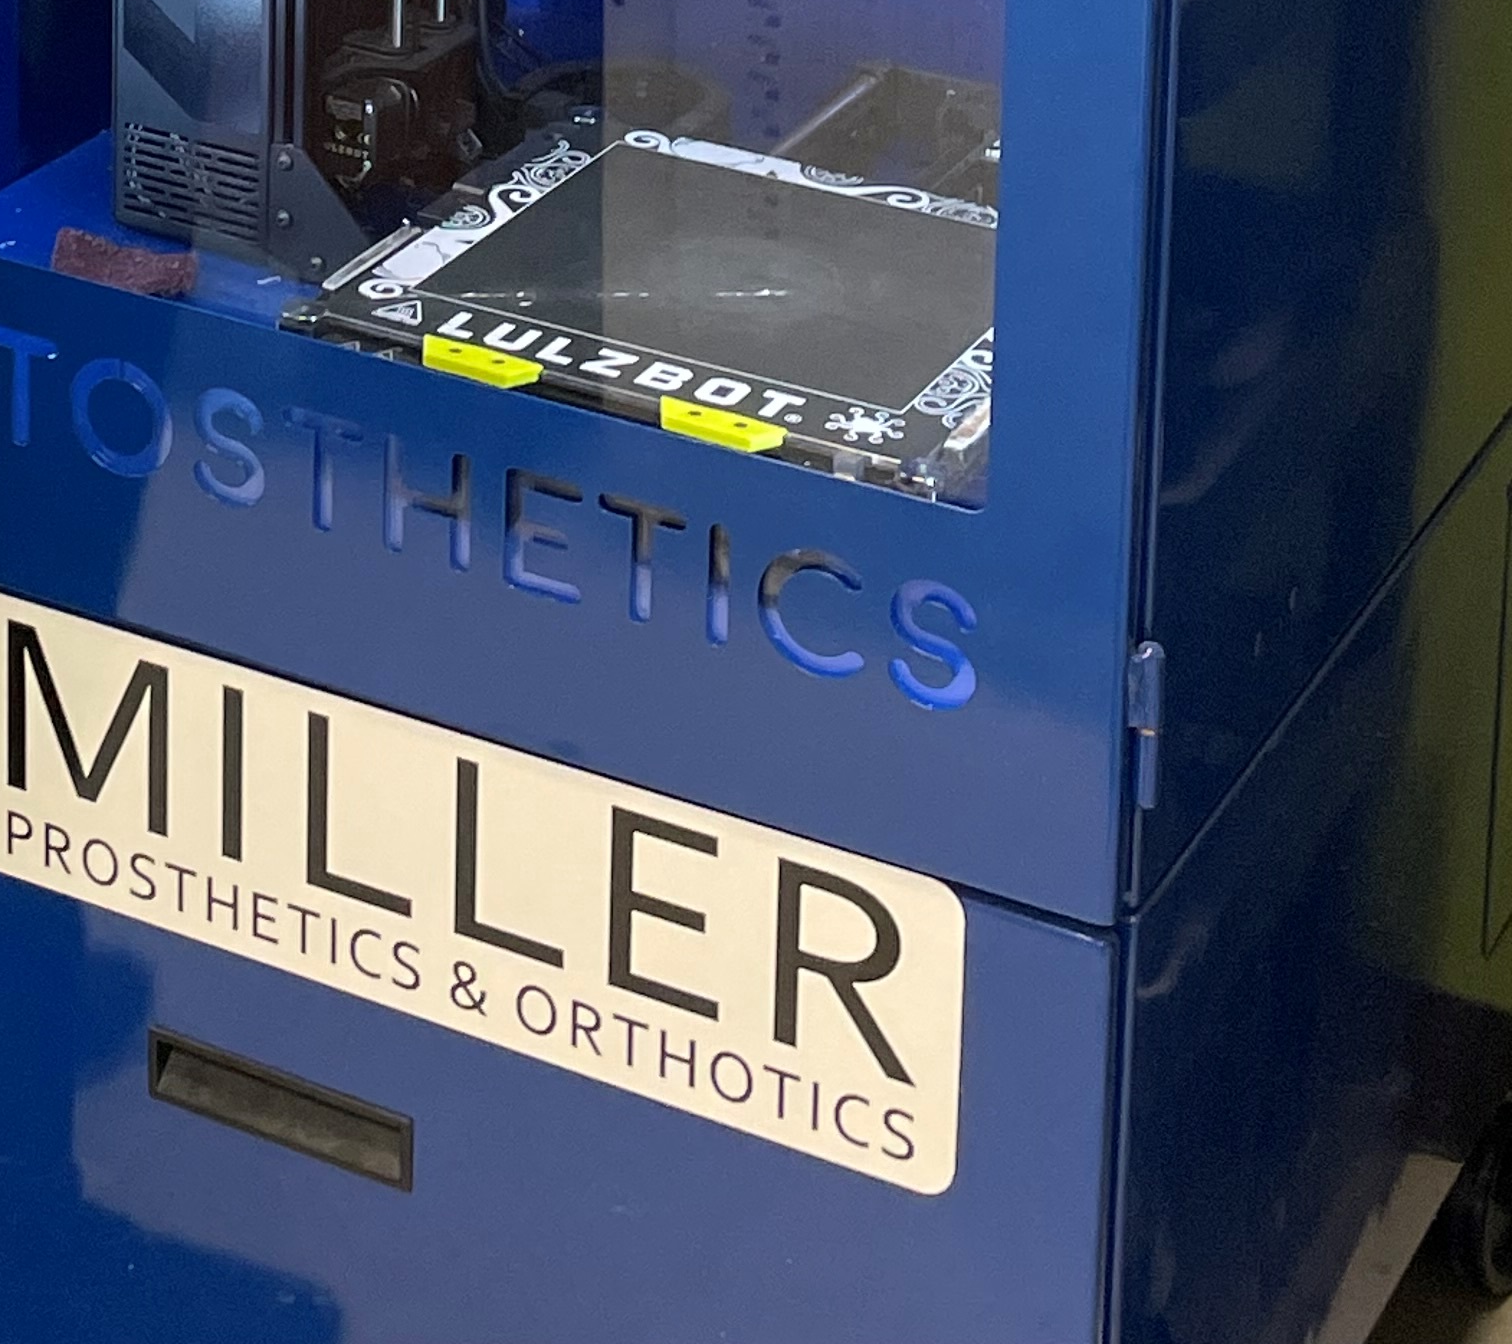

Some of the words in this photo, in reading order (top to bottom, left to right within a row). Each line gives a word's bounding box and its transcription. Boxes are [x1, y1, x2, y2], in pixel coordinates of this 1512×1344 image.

[6, 618, 916, 1086] MILLER
[6, 810, 421, 991] PROSTHETICS
[449, 961, 488, 1017] &
[515, 984, 916, 1161] ORTHOTICS
